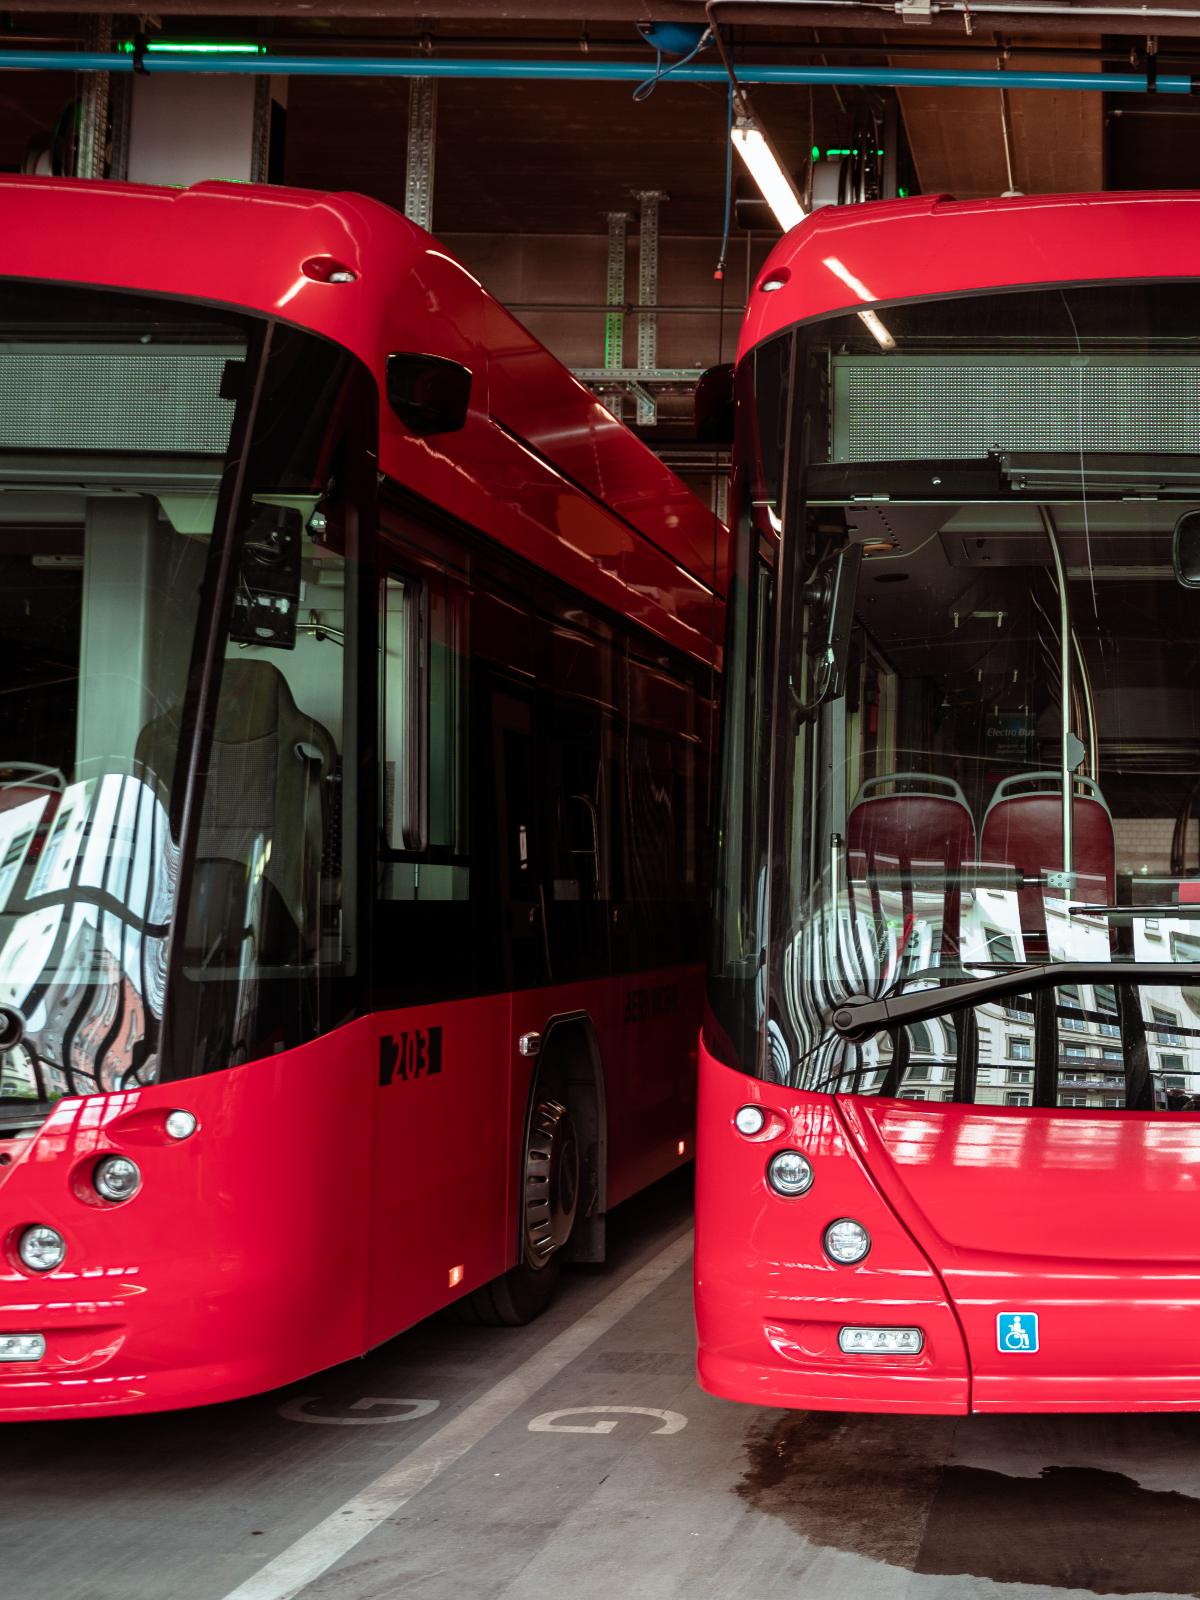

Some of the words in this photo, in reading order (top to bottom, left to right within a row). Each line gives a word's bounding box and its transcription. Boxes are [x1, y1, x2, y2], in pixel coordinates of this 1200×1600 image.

[987, 727, 1017, 737] Electro
[1018, 727, 1036, 737] Bus
[389, 1027, 431, 1086] 203
